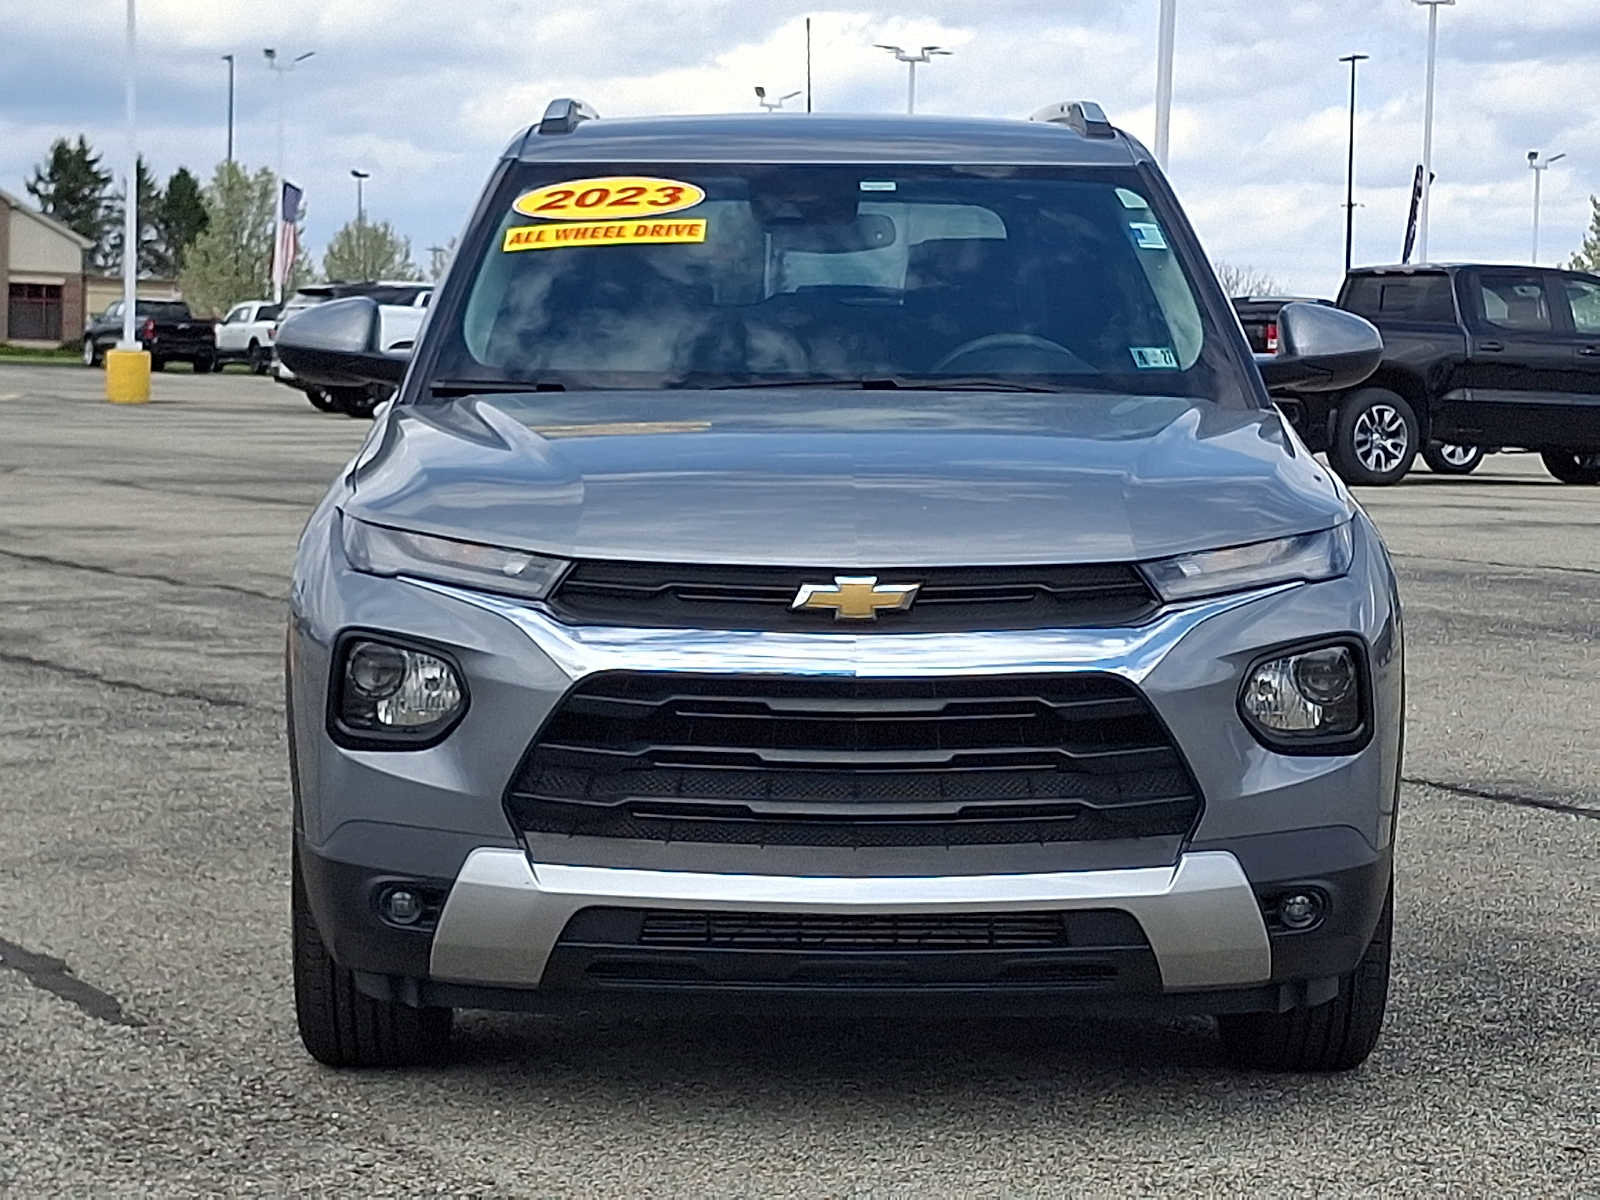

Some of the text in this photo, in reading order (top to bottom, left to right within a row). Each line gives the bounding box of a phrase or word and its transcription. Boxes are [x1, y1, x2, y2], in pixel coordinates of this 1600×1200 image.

[534, 186, 685, 212] 2023
[508, 223, 702, 246] ALL WHEEL DRIVE
